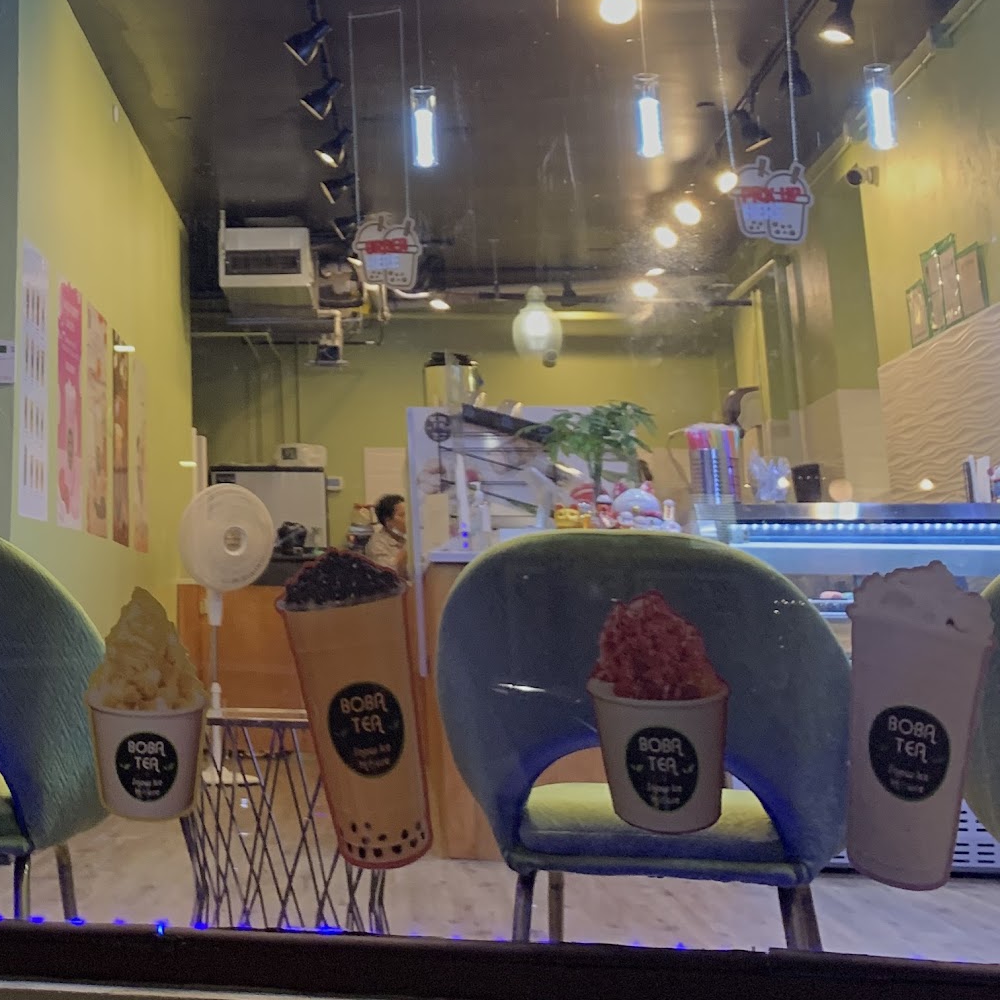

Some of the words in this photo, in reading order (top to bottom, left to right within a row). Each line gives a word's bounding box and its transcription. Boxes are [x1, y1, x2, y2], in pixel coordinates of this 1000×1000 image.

[340, 692, 388, 714] BOBA
[351, 714, 386, 735] TEA
[887, 714, 938, 746] BOBA
[127, 740, 166, 758] BOBA
[638, 736, 685, 757] BOBA
[895, 736, 928, 765] TEA
[134, 756, 161, 774] TEA
[647, 755, 680, 777] TEA
